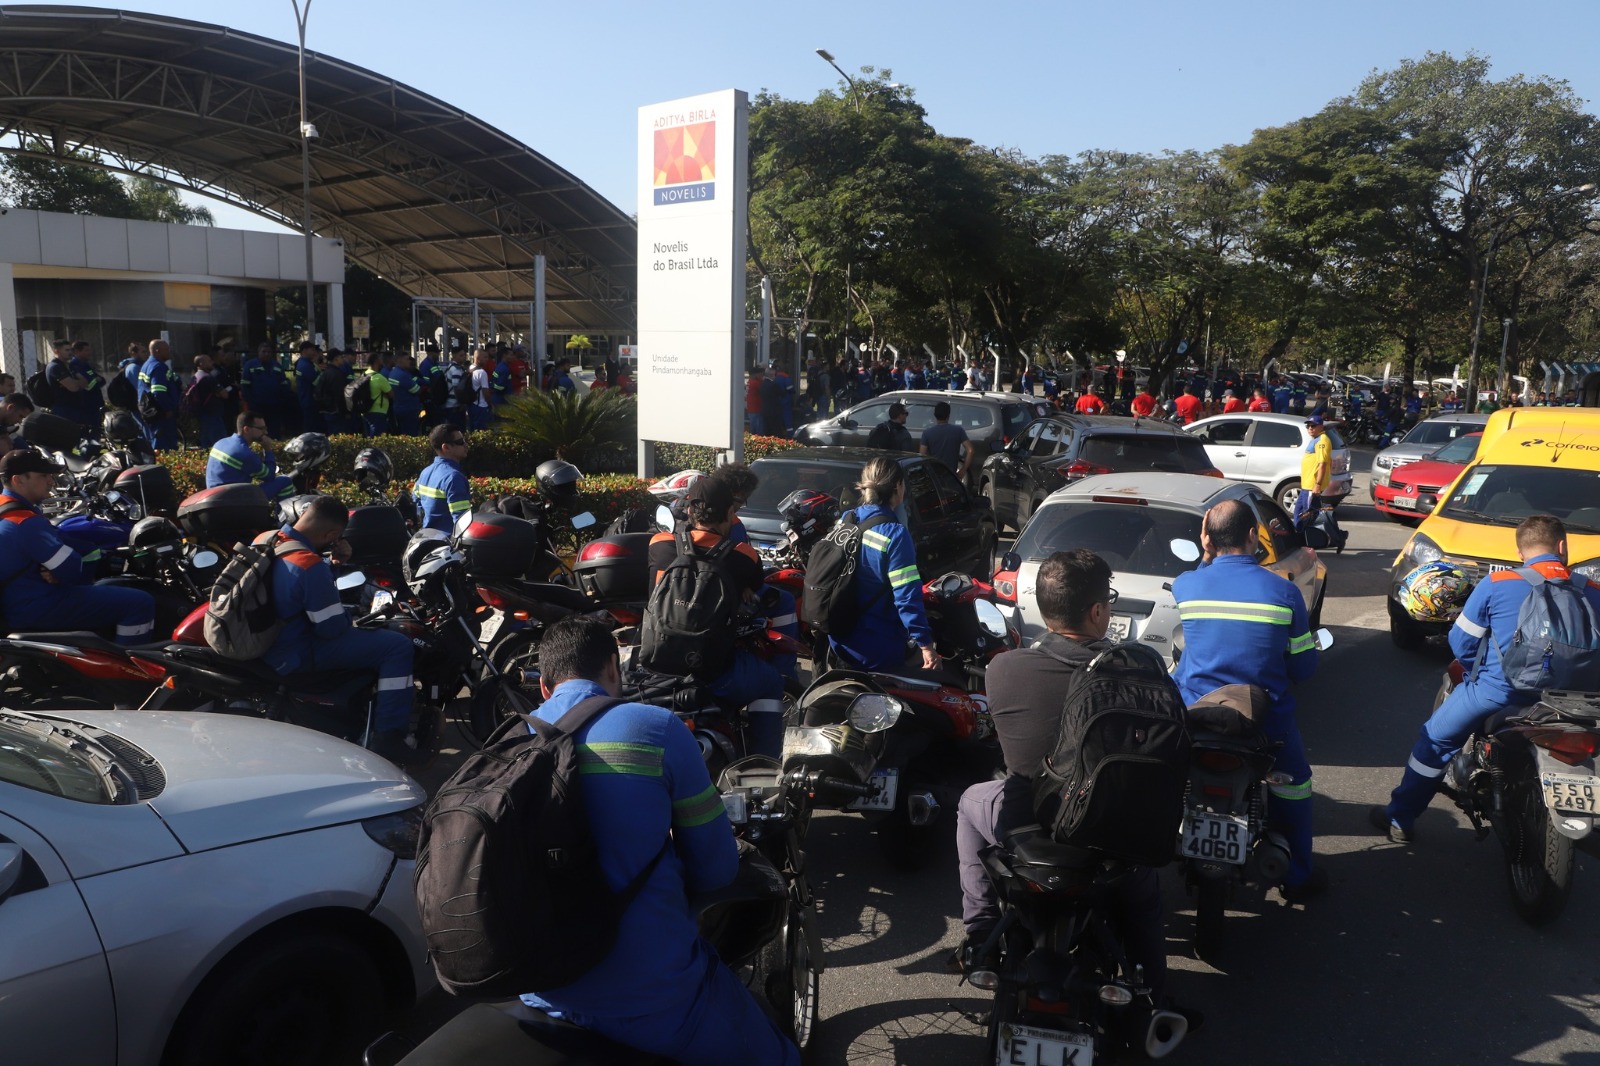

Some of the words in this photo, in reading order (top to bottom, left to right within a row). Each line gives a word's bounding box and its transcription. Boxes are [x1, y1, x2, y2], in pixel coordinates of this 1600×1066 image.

[654, 114, 686, 128] ADITYA
[689, 109, 716, 123] BIRLA
[661, 186, 707, 202] NOVELIS
[653, 241, 689, 254] Novelis
[653, 259, 666, 271] do
[668, 258, 695, 271] Brasil
[697, 257, 719, 270] Ltda
[652, 354, 679, 363] Unidade
[652, 365, 712, 377] Pindamonhangaba
[1552, 782, 1593, 799] ESQ
[1552, 795, 1596, 811] 2497
[1191, 819, 1239, 842] FDR
[1188, 837, 1240, 861] 4060
[1010, 1038, 1080, 1066] ELK
